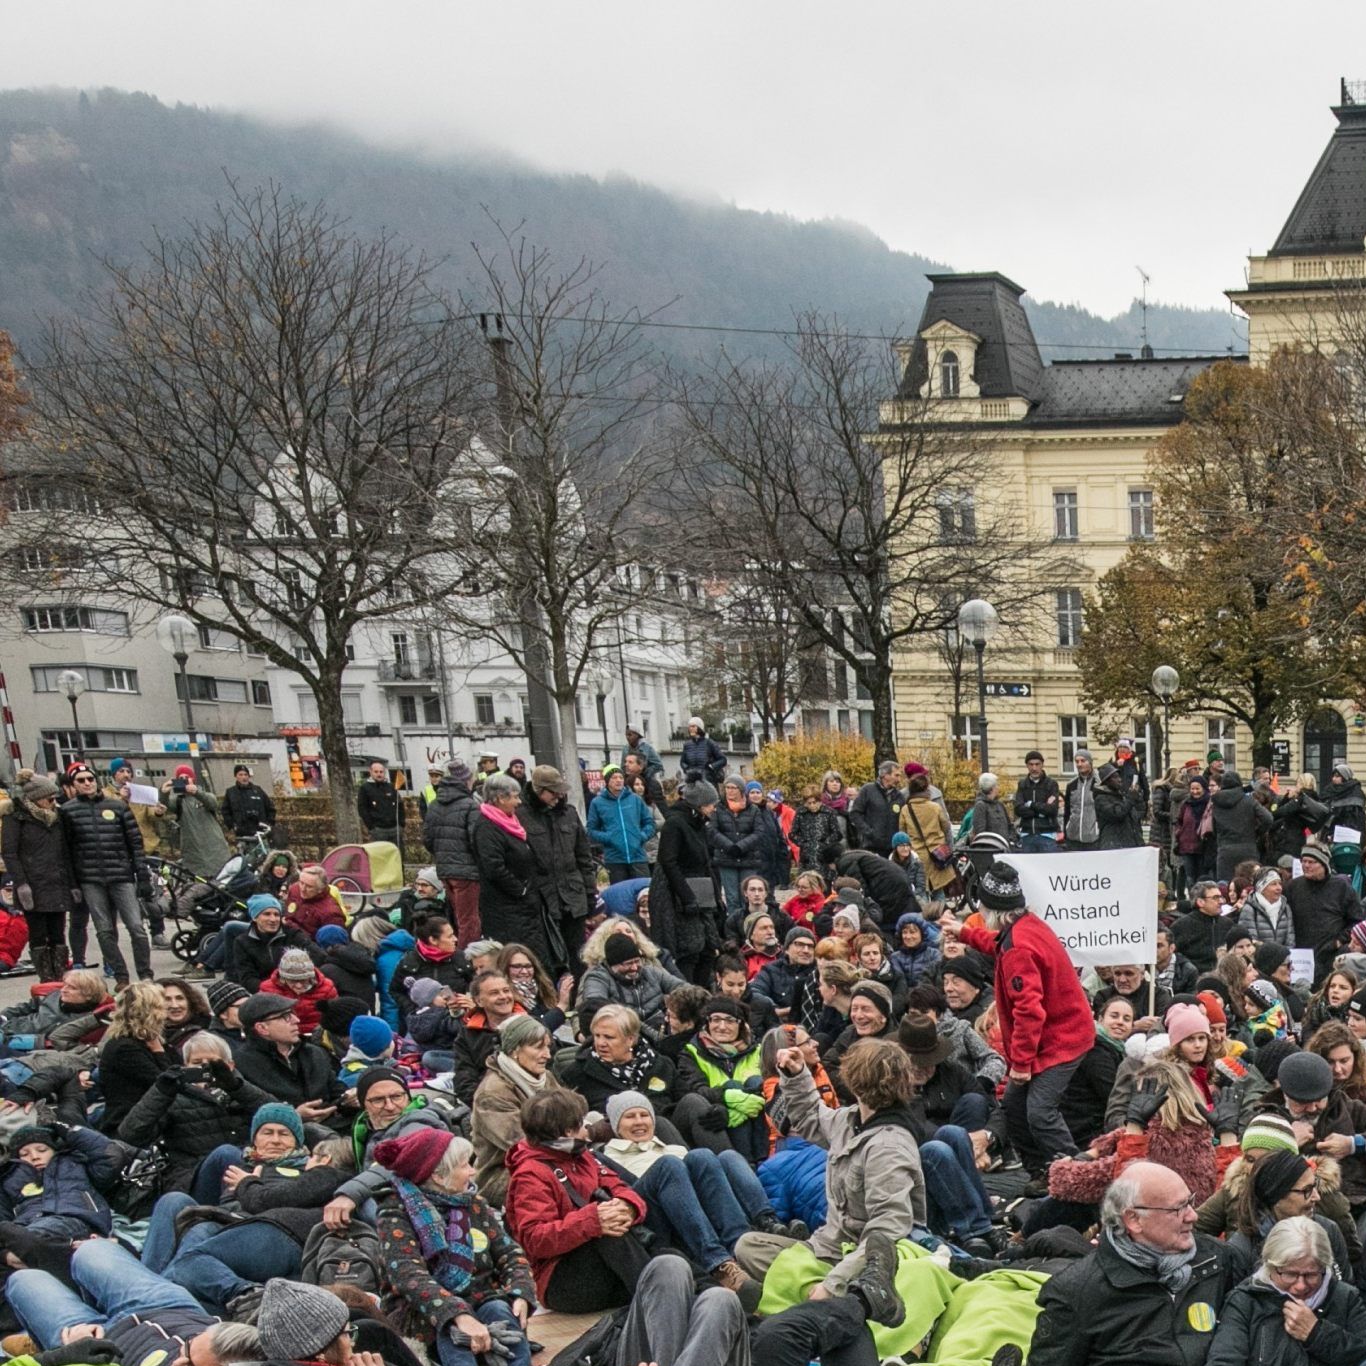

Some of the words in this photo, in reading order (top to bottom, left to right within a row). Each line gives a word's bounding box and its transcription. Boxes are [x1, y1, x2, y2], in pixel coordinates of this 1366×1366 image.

[1049, 873, 1111, 891] Würde
[1044, 900, 1120, 920] Anstand
[1058, 926, 1147, 948] schlichkei
